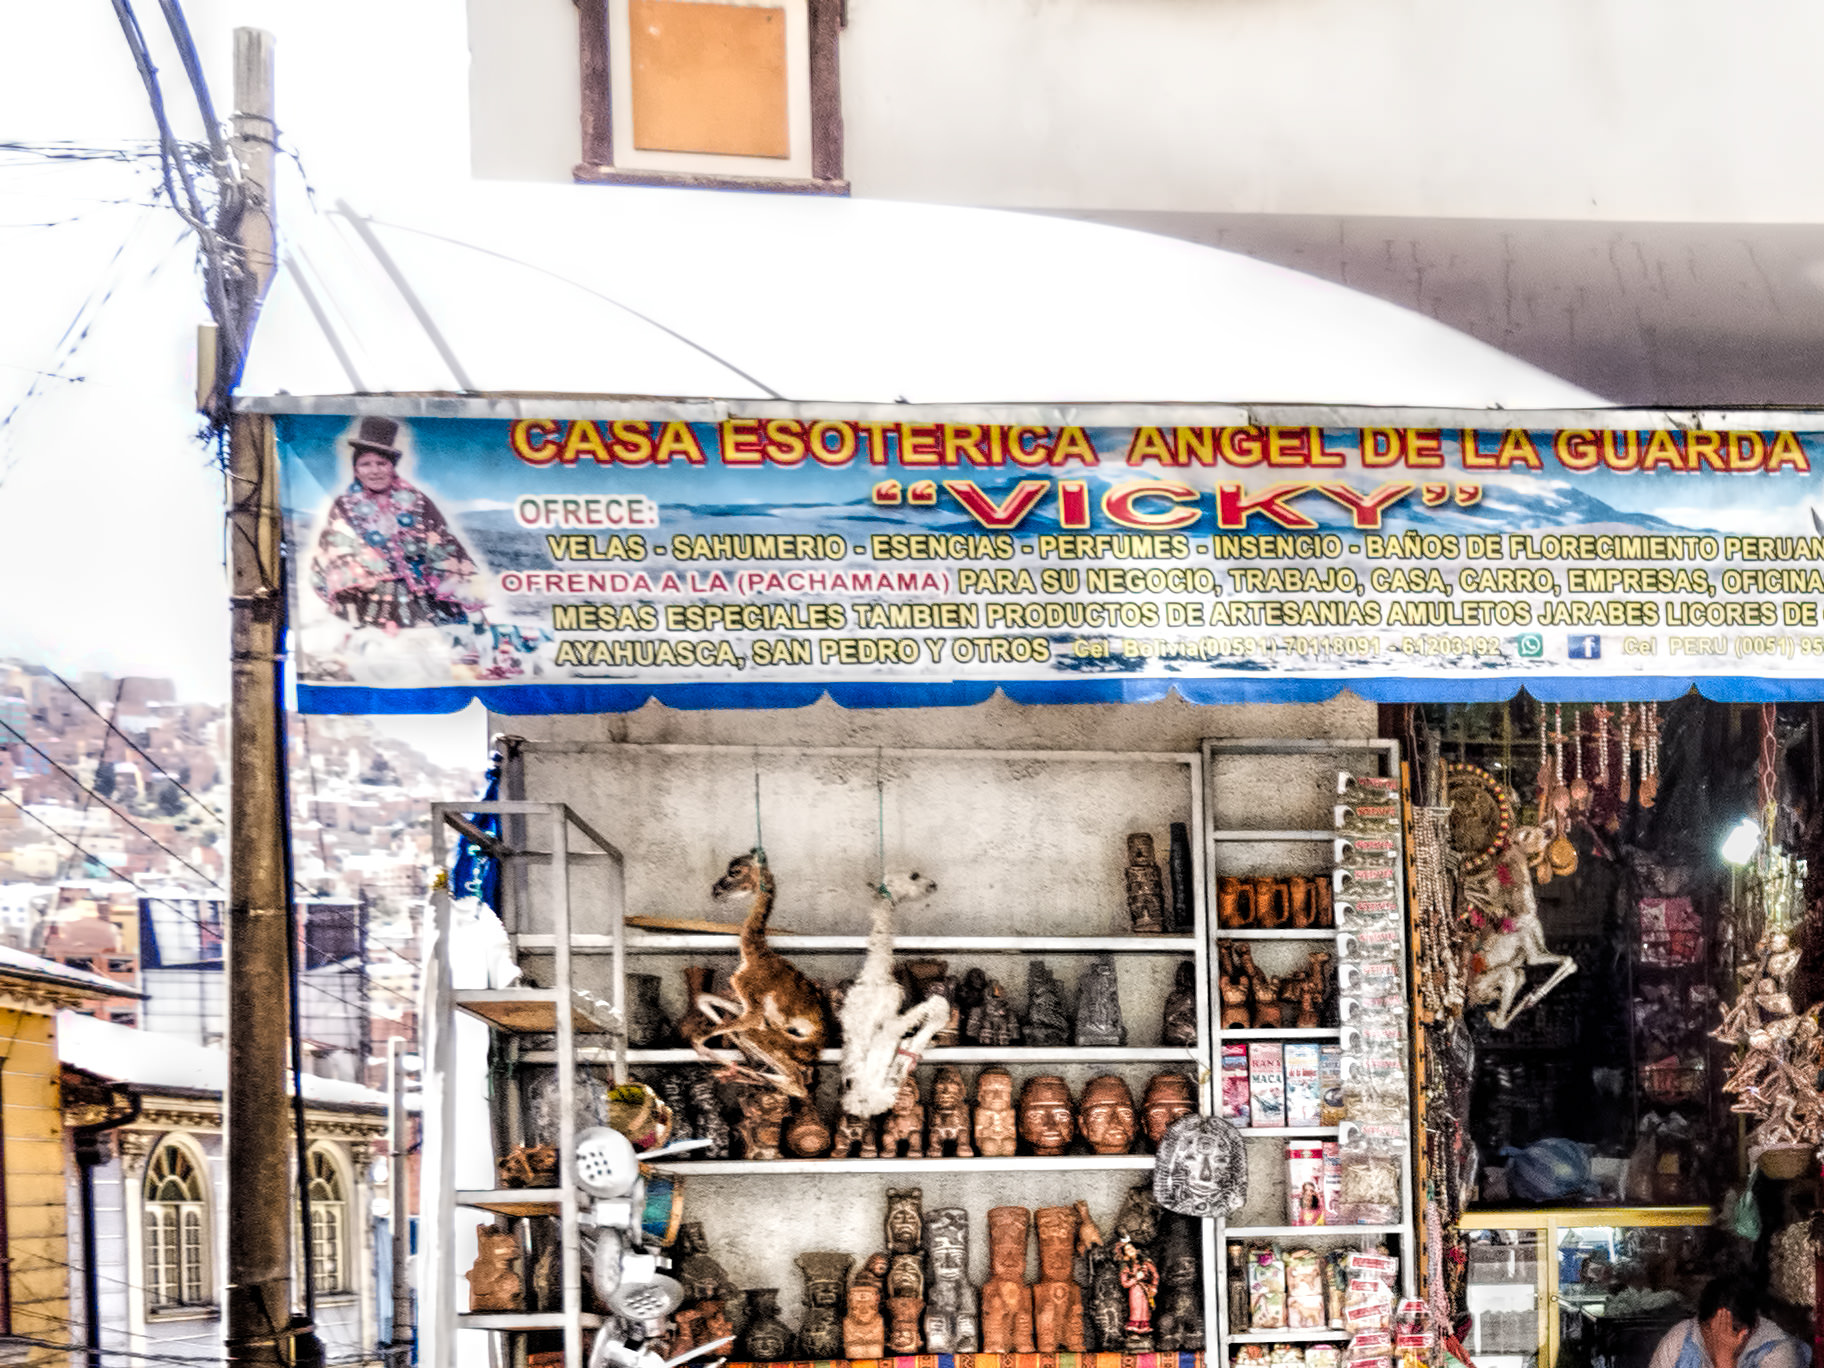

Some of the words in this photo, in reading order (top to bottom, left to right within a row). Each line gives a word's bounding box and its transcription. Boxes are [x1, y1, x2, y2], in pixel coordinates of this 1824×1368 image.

[510, 419, 706, 466] CASA
[720, 420, 1100, 468] ESOTERICA
[1127, 426, 1345, 468] ANGEL
[1360, 427, 1445, 468] DE
[1459, 428, 1543, 470] LA
[1555, 429, 1811, 473] GUARDA
[519, 497, 655, 525] OFRECE:
[548, 535, 647, 561] VELAS
[672, 535, 846, 561] SAHUMERIO
[872, 535, 1014, 560] ESENCIAS
[1039, 535, 1190, 560] PERFUMES
[1214, 534, 1343, 560] INSENCIO
[1366, 530, 1460, 560] BAÑOS
[1467, 535, 1502, 559] DE
[1509, 535, 1718, 560] FLORECIMIENTO
[501, 572, 651, 593] OFRENDA
[661, 572, 681, 593] A
[691, 572, 729, 593] LA
[738, 571, 950, 595] (PACHAMAMA)
[958, 569, 1035, 593] PARA
[1042, 569, 1079, 593] SU
[1087, 569, 1222, 597] NEGOCIO,
[1229, 568, 1364, 597] TRABAJO,
[1371, 568, 1452, 597] CASA,
[1459, 568, 1561, 597] CARRO,
[1568, 569, 1716, 597] EMPRESAS,
[553, 605, 658, 631] MESAS
[665, 604, 847, 631] ESPECIALES
[854, 604, 978, 630] TAMBIEN
[986, 603, 1159, 629] PRODUCTOS
[1167, 602, 1205, 628] DE
[1210, 601, 1381, 627] ARTESANIAS
[1387, 601, 1531, 626] AMULETOS
[1538, 601, 1660, 626] JARABES
[1666, 602, 1777, 626] LICORES
[1783, 602, 1817, 626] DE
[556, 641, 747, 670] AYAHUASCA,
[752, 640, 812, 665] SAN
[820, 639, 919, 665] PEDRO
[925, 638, 946, 663] Y
[953, 638, 1050, 663] OTROS
[1074, 638, 1109, 659] Cel
[1285, 636, 1381, 656] 70118091
[1402, 636, 1501, 656] 61203192
[1624, 636, 1657, 656] Cel
[1669, 636, 1728, 656] PERU
[1734, 636, 1795, 660] (0051)
